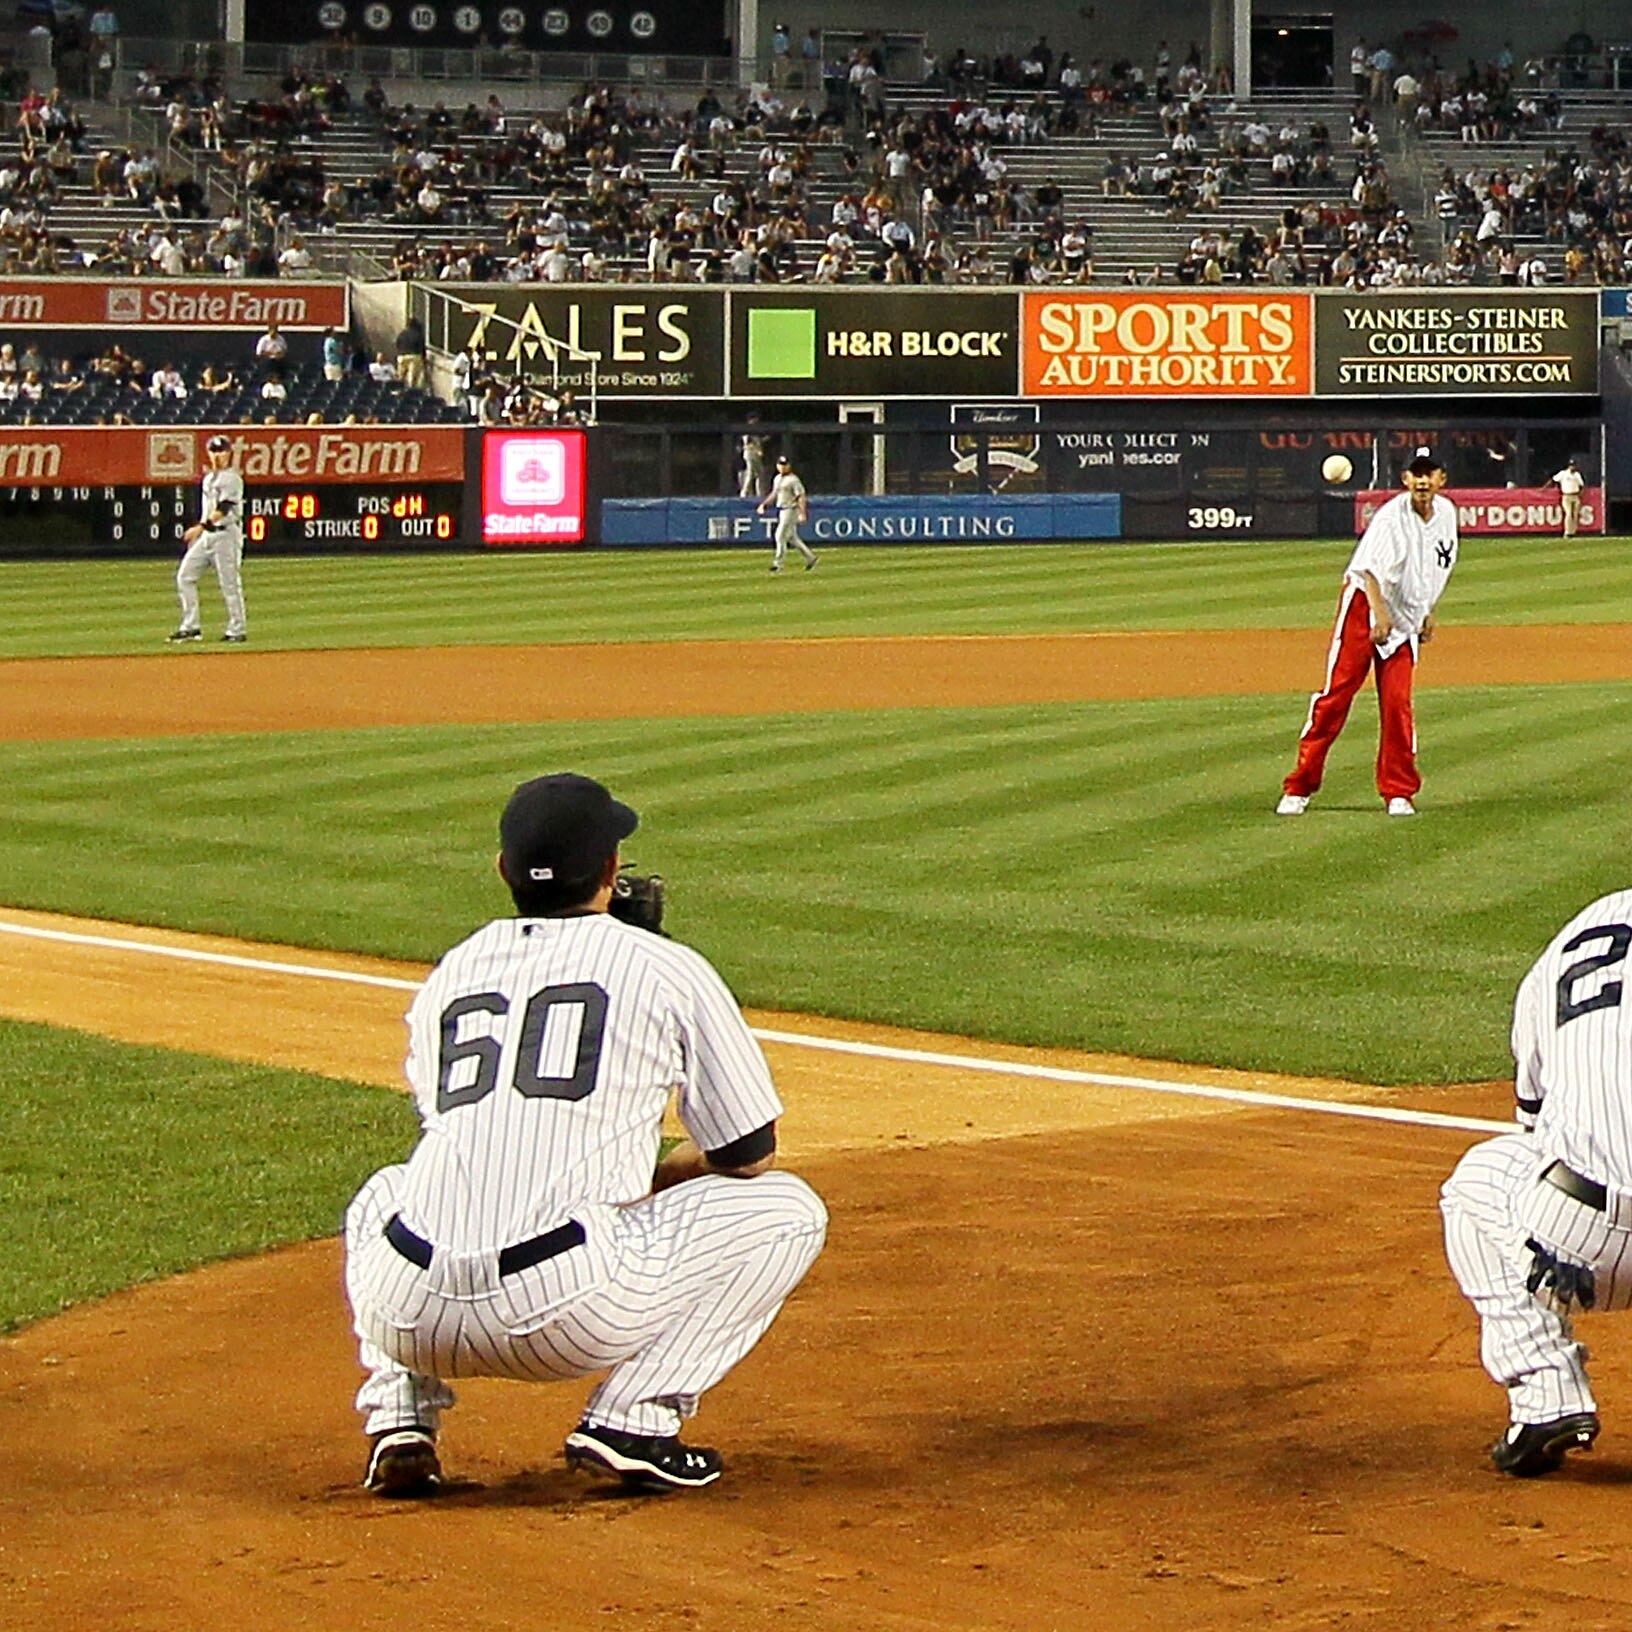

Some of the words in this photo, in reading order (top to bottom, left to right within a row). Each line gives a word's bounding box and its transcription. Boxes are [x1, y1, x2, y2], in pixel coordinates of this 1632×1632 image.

[146, 289, 226, 321] State
[228, 289, 307, 320] Farm
[1039, 302, 1293, 354] SPORTS
[1344, 308, 1568, 331] YANKEES-STEINER
[461, 302, 690, 361] ZALES
[1368, 332, 1543, 354] COLLECTIBLES
[827, 332, 891, 358] H&R
[901, 332, 1002, 358] BLOCK
[622, 371, 657, 386] Since
[1040, 355, 1292, 387] AUTHORITY
[1339, 362, 1571, 385] STEINERSPORTS.COM
[1056, 433, 1101, 448] YOUR
[315, 434, 420, 475] Farm
[252, 498, 281, 516] BAT
[285, 495, 315, 517] 28
[358, 497, 390, 515] POS
[1488, 505, 1594, 528] DONUS
[305, 521, 360, 538] STRIKE
[401, 519, 433, 536] OUT
[815, 517, 1015, 537] CONSULTING
[1187, 507, 1253, 529] 399FT
[437, 980, 606, 1113] 60
